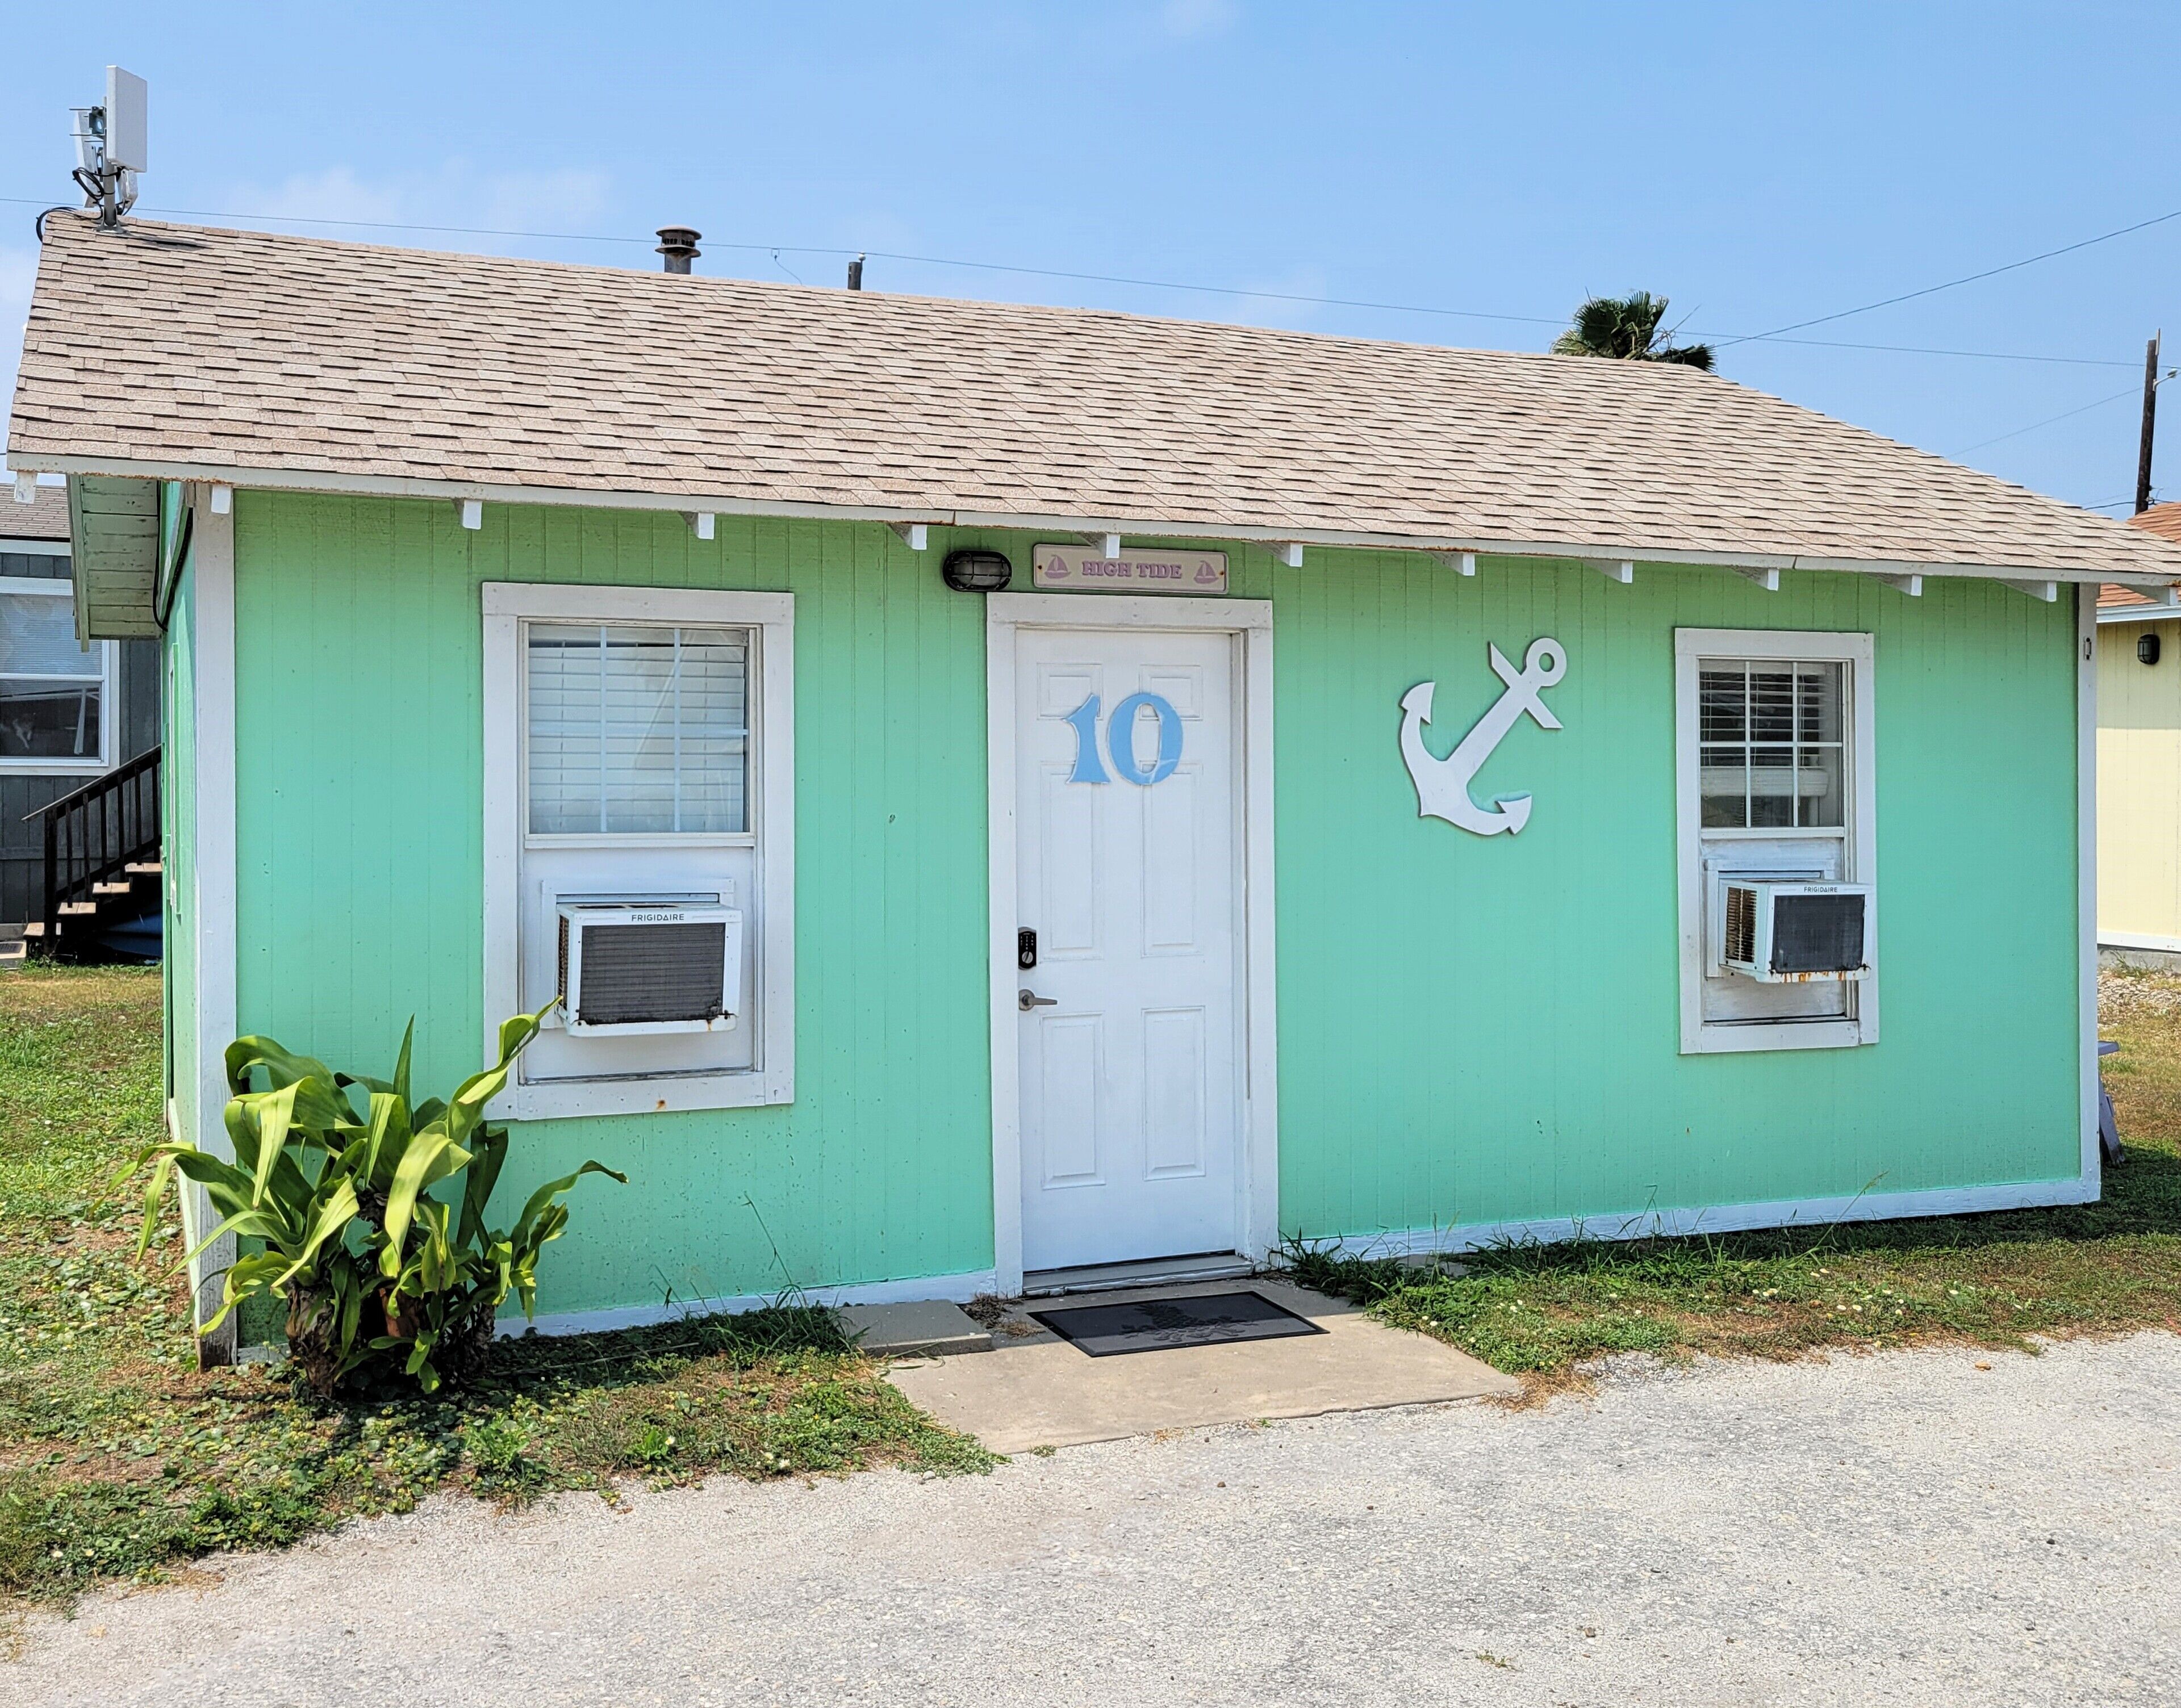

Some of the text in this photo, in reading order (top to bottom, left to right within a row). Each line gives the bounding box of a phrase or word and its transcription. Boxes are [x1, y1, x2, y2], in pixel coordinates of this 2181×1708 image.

[1082, 560, 1183, 579] HIGH TIDE
[1061, 693, 1183, 785] 10
